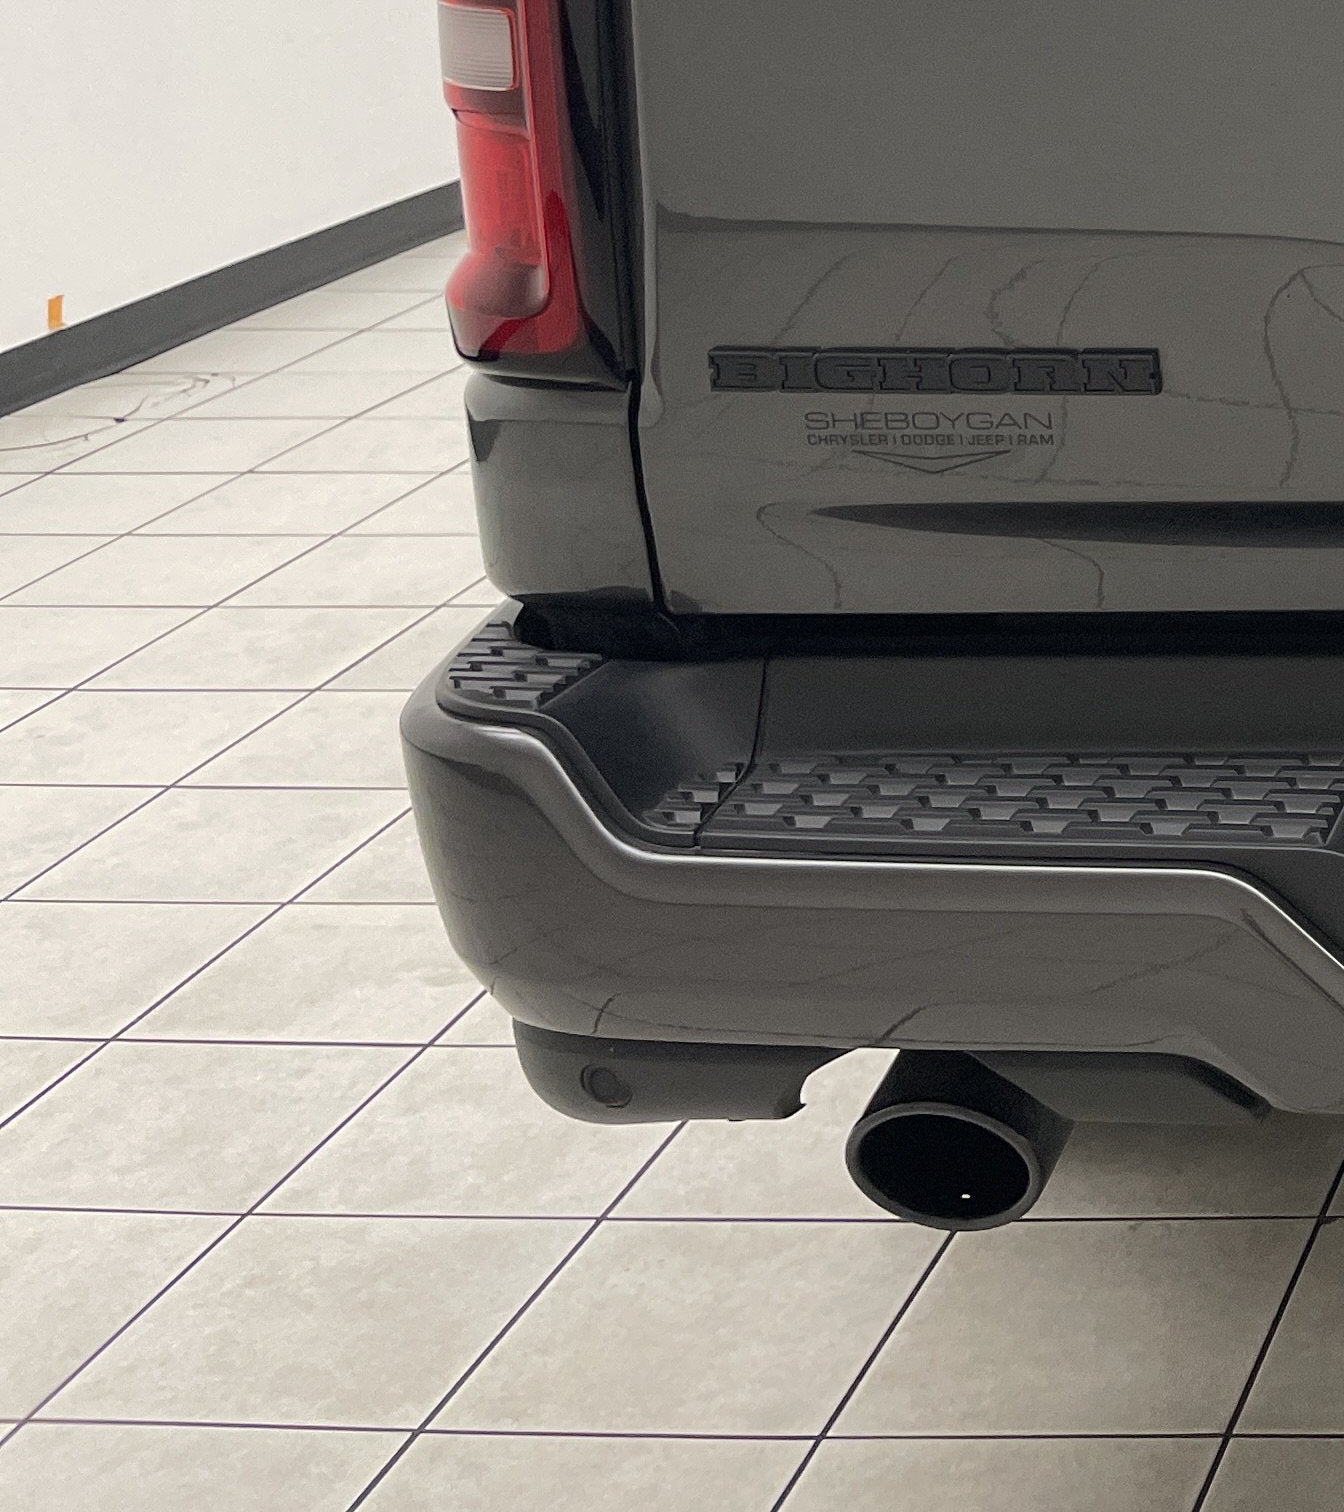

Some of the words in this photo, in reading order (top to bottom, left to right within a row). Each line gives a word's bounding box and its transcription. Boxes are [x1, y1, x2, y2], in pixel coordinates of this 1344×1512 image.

[804, 411, 1053, 430] SHEBOYGAN
[807, 434, 888, 446] CHRYSLER
[901, 434, 958, 446] DODGE
[968, 434, 1004, 446] JEEP
[1017, 434, 1055, 446] RAM
